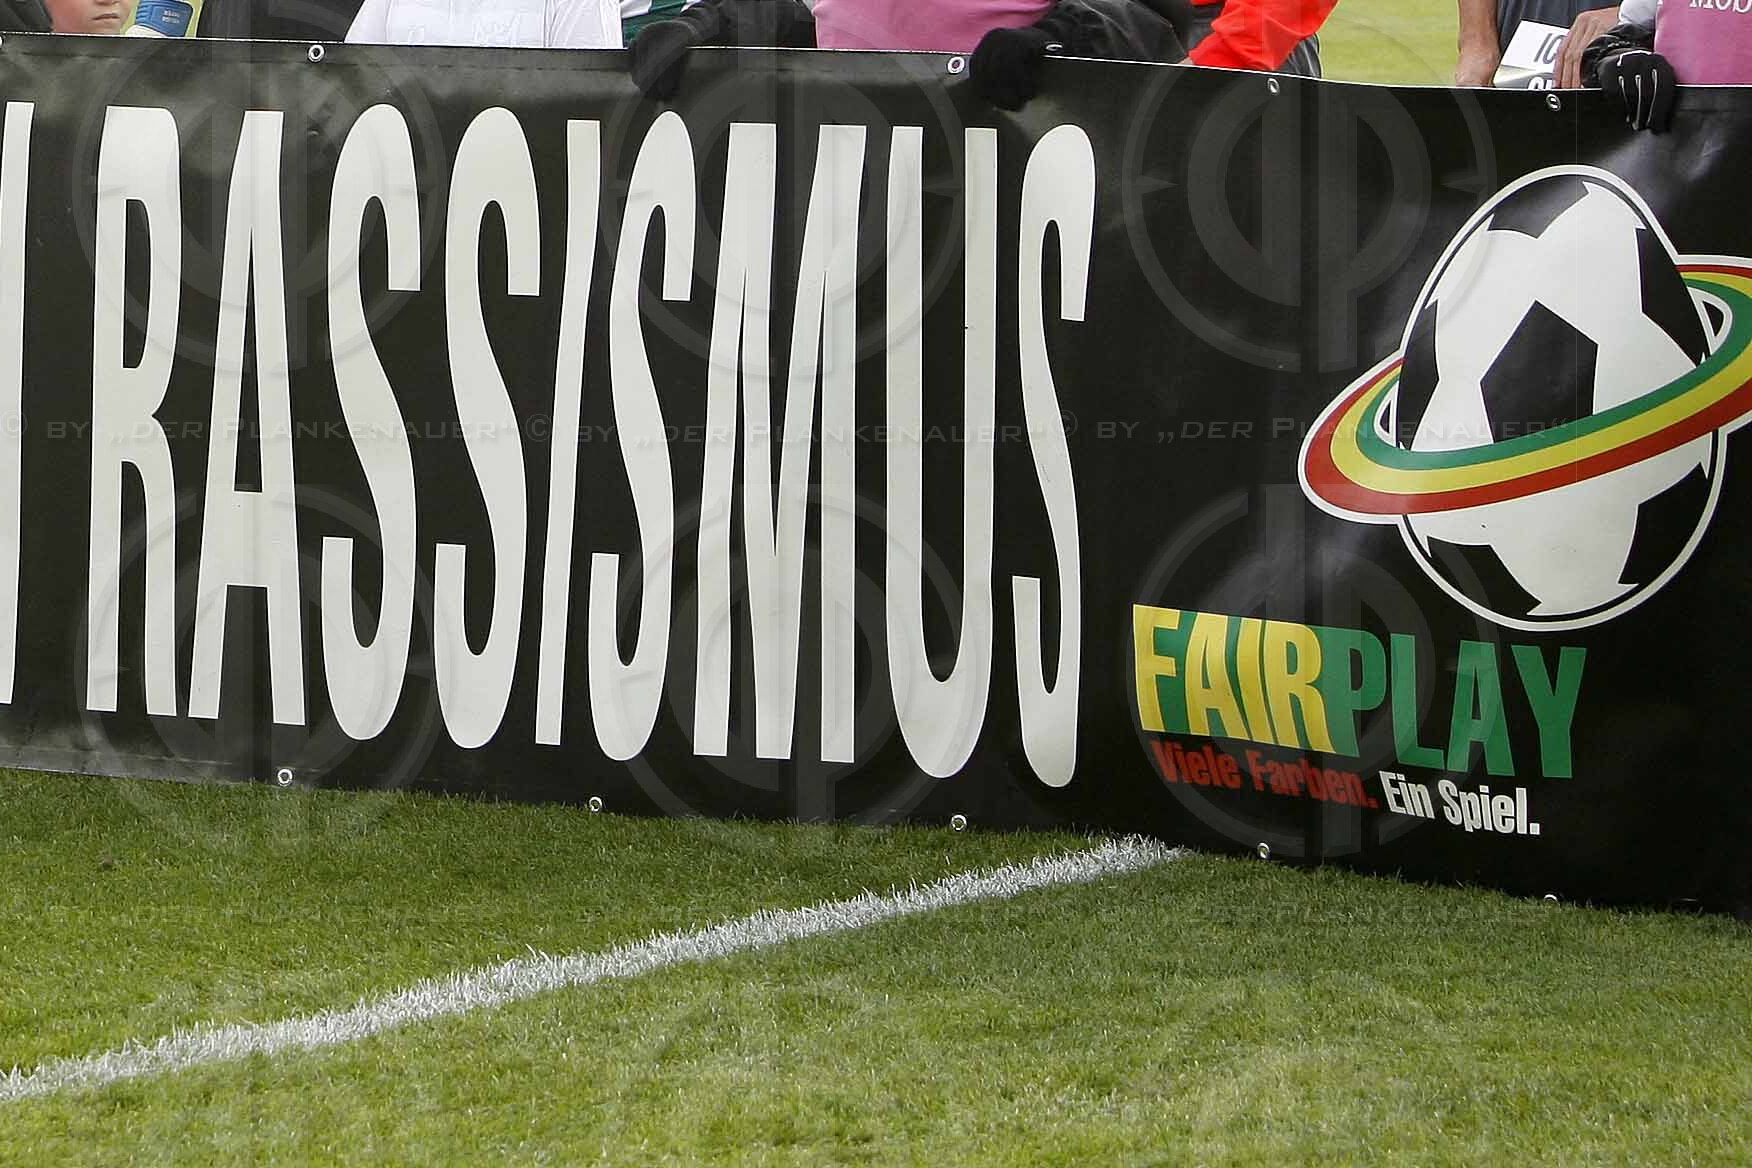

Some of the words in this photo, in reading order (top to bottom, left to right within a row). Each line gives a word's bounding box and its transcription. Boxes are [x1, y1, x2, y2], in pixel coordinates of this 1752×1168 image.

[86, 103, 1096, 787] RASSISMUS
[1152, 740, 1241, 789] Viele
[1247, 750, 1379, 810] Farben.
[1379, 771, 1435, 820] Ein
[1442, 778, 1541, 835] Spiel.
